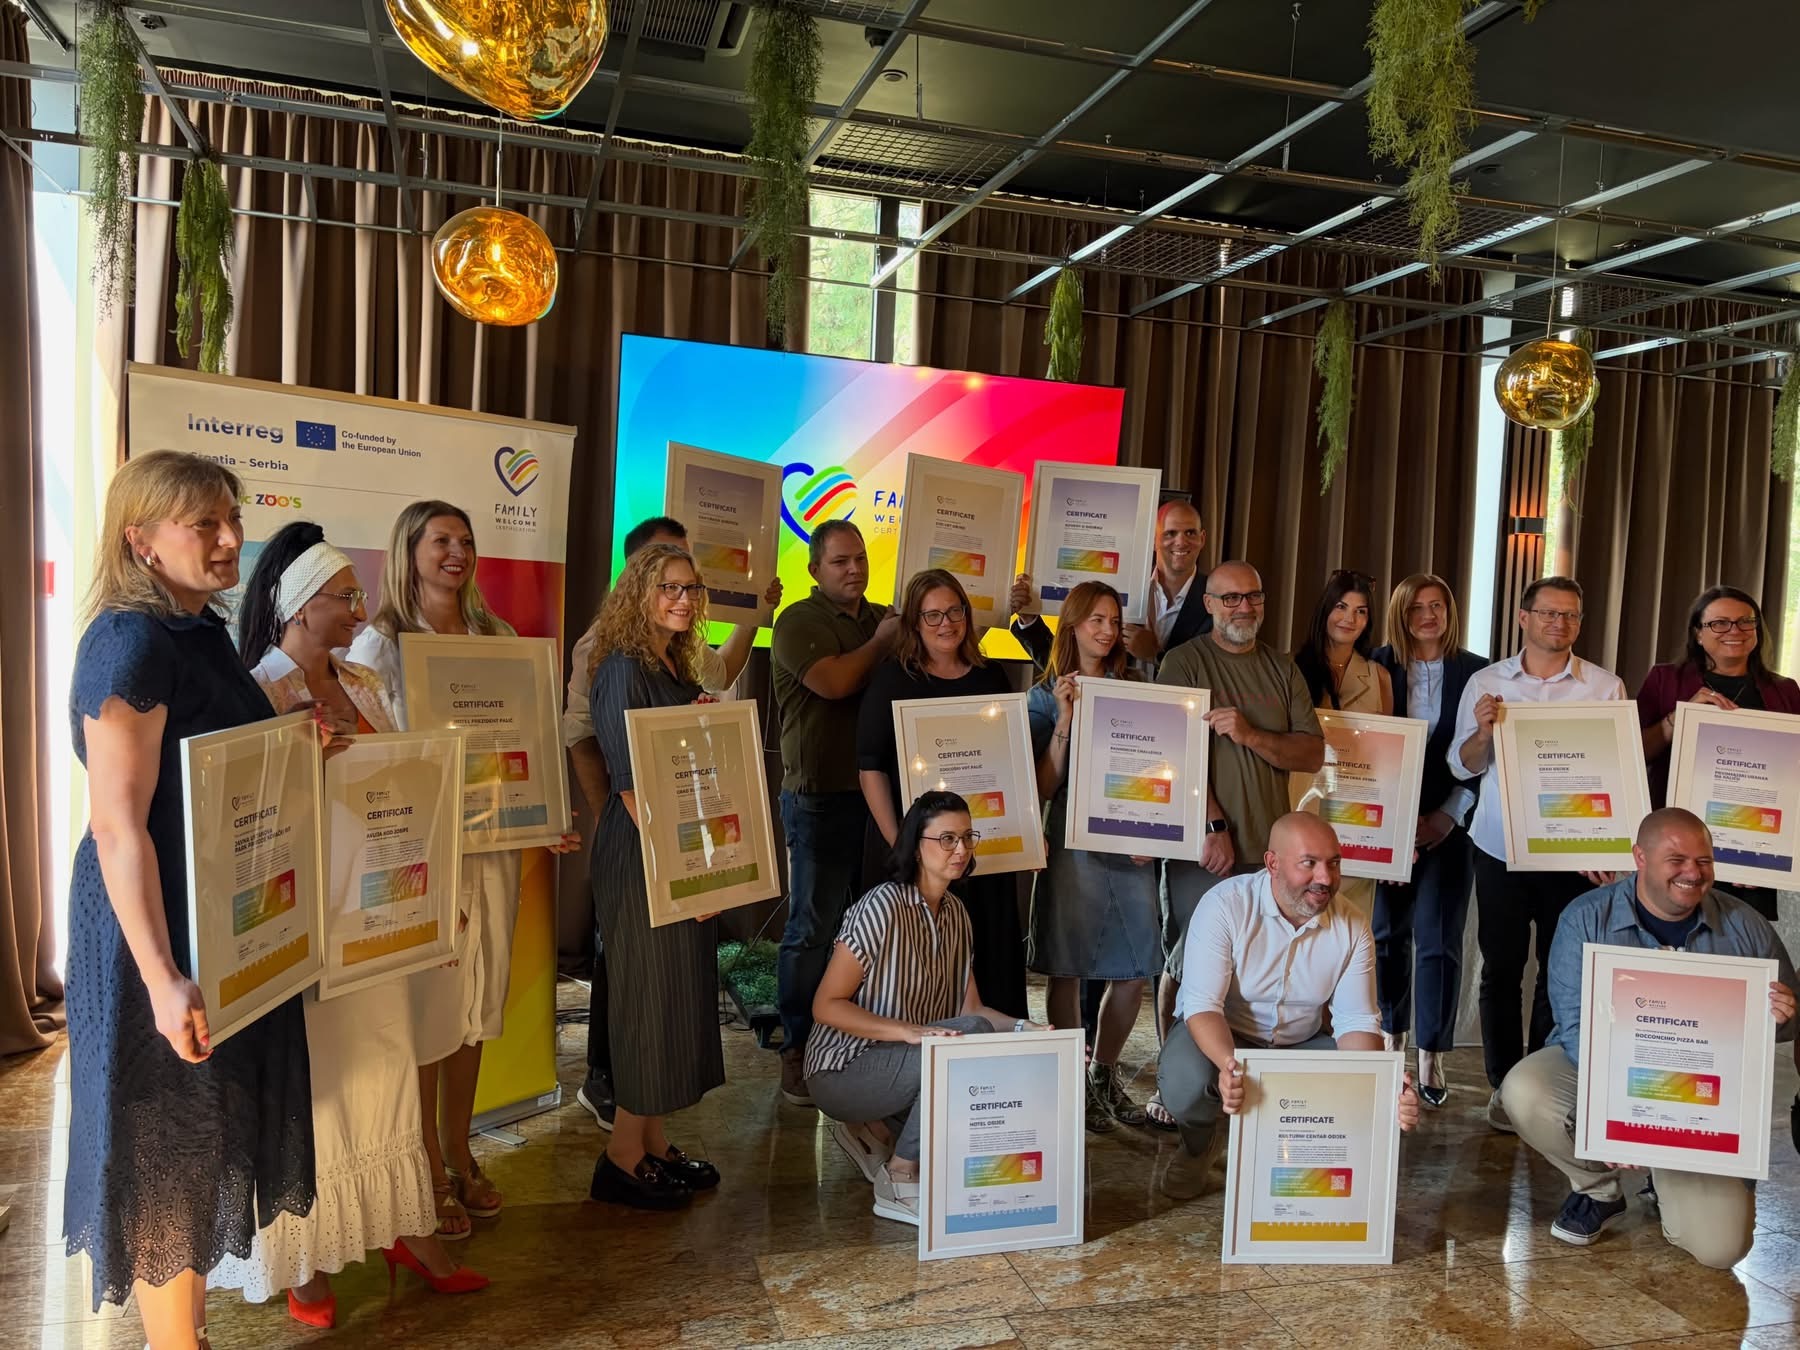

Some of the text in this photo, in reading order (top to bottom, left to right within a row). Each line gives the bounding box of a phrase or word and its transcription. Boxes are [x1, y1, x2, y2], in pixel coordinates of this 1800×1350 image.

[188, 413, 284, 444] Interreg
[341, 430, 397, 446] Co-funded by
[342, 441, 422, 458] the European Union
[249, 458, 289, 471] Serbia
[495, 503, 538, 518] FAMILY
[936, 508, 976, 521] CERTIFICATE
[1066, 510, 1108, 520] CERTIFICATE
[496, 518, 537, 527] WELCOME
[452, 700, 505, 709] CERTIFICATE
[1111, 732, 1156, 743] CERTIFICATE
[938, 749, 983, 760] CERTIFICATE
[1537, 752, 1585, 760] CERTIFICATE
[1716, 758, 1767, 771] CERTIFICATE
[675, 767, 718, 780] CERTIFICATE
[234, 805, 278, 829] CERTIFICATE
[367, 806, 413, 820] CERTIFICATE
[1636, 1015, 1699, 1028] CERTIFICATE
[1676, 1036, 1695, 1044] PIZZA
[970, 1100, 1023, 1111] CERTIFICATE
[1279, 1116, 1335, 1124] CERTIFICATE
